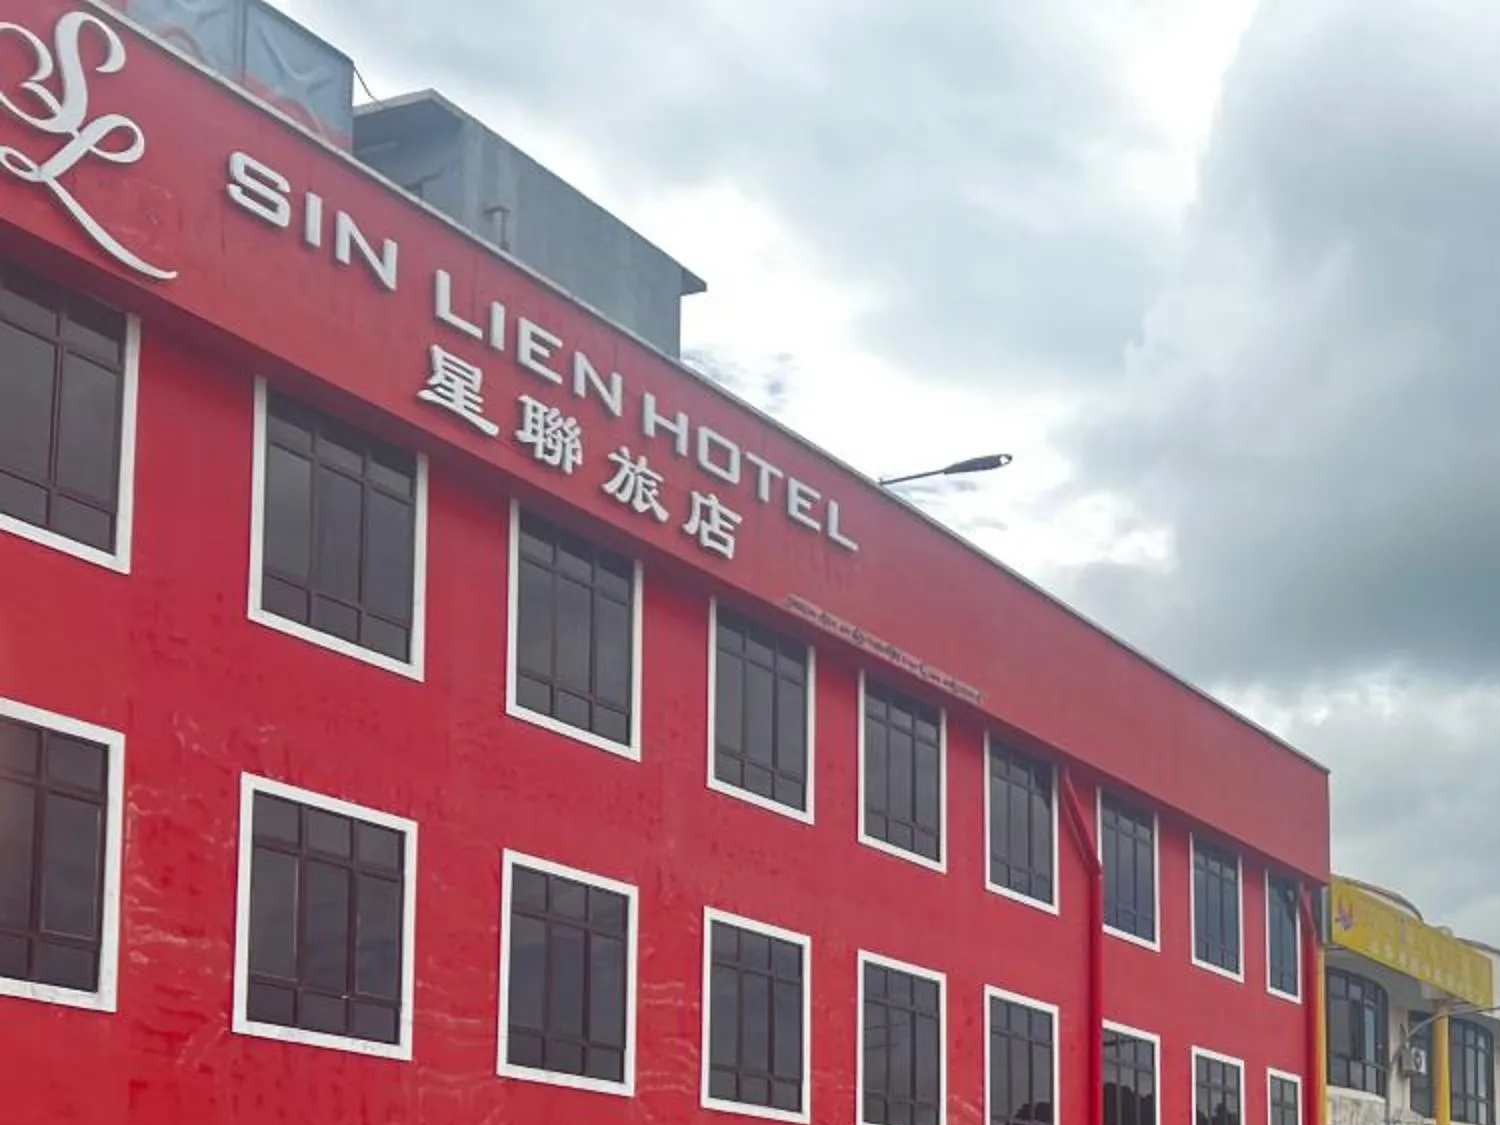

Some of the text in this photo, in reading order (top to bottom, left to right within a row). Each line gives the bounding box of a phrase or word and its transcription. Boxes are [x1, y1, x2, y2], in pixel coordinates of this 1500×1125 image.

[227, 151, 859, 552] SIN LIEN HOTEL
[417, 344, 743, 560] 星聯旅店
